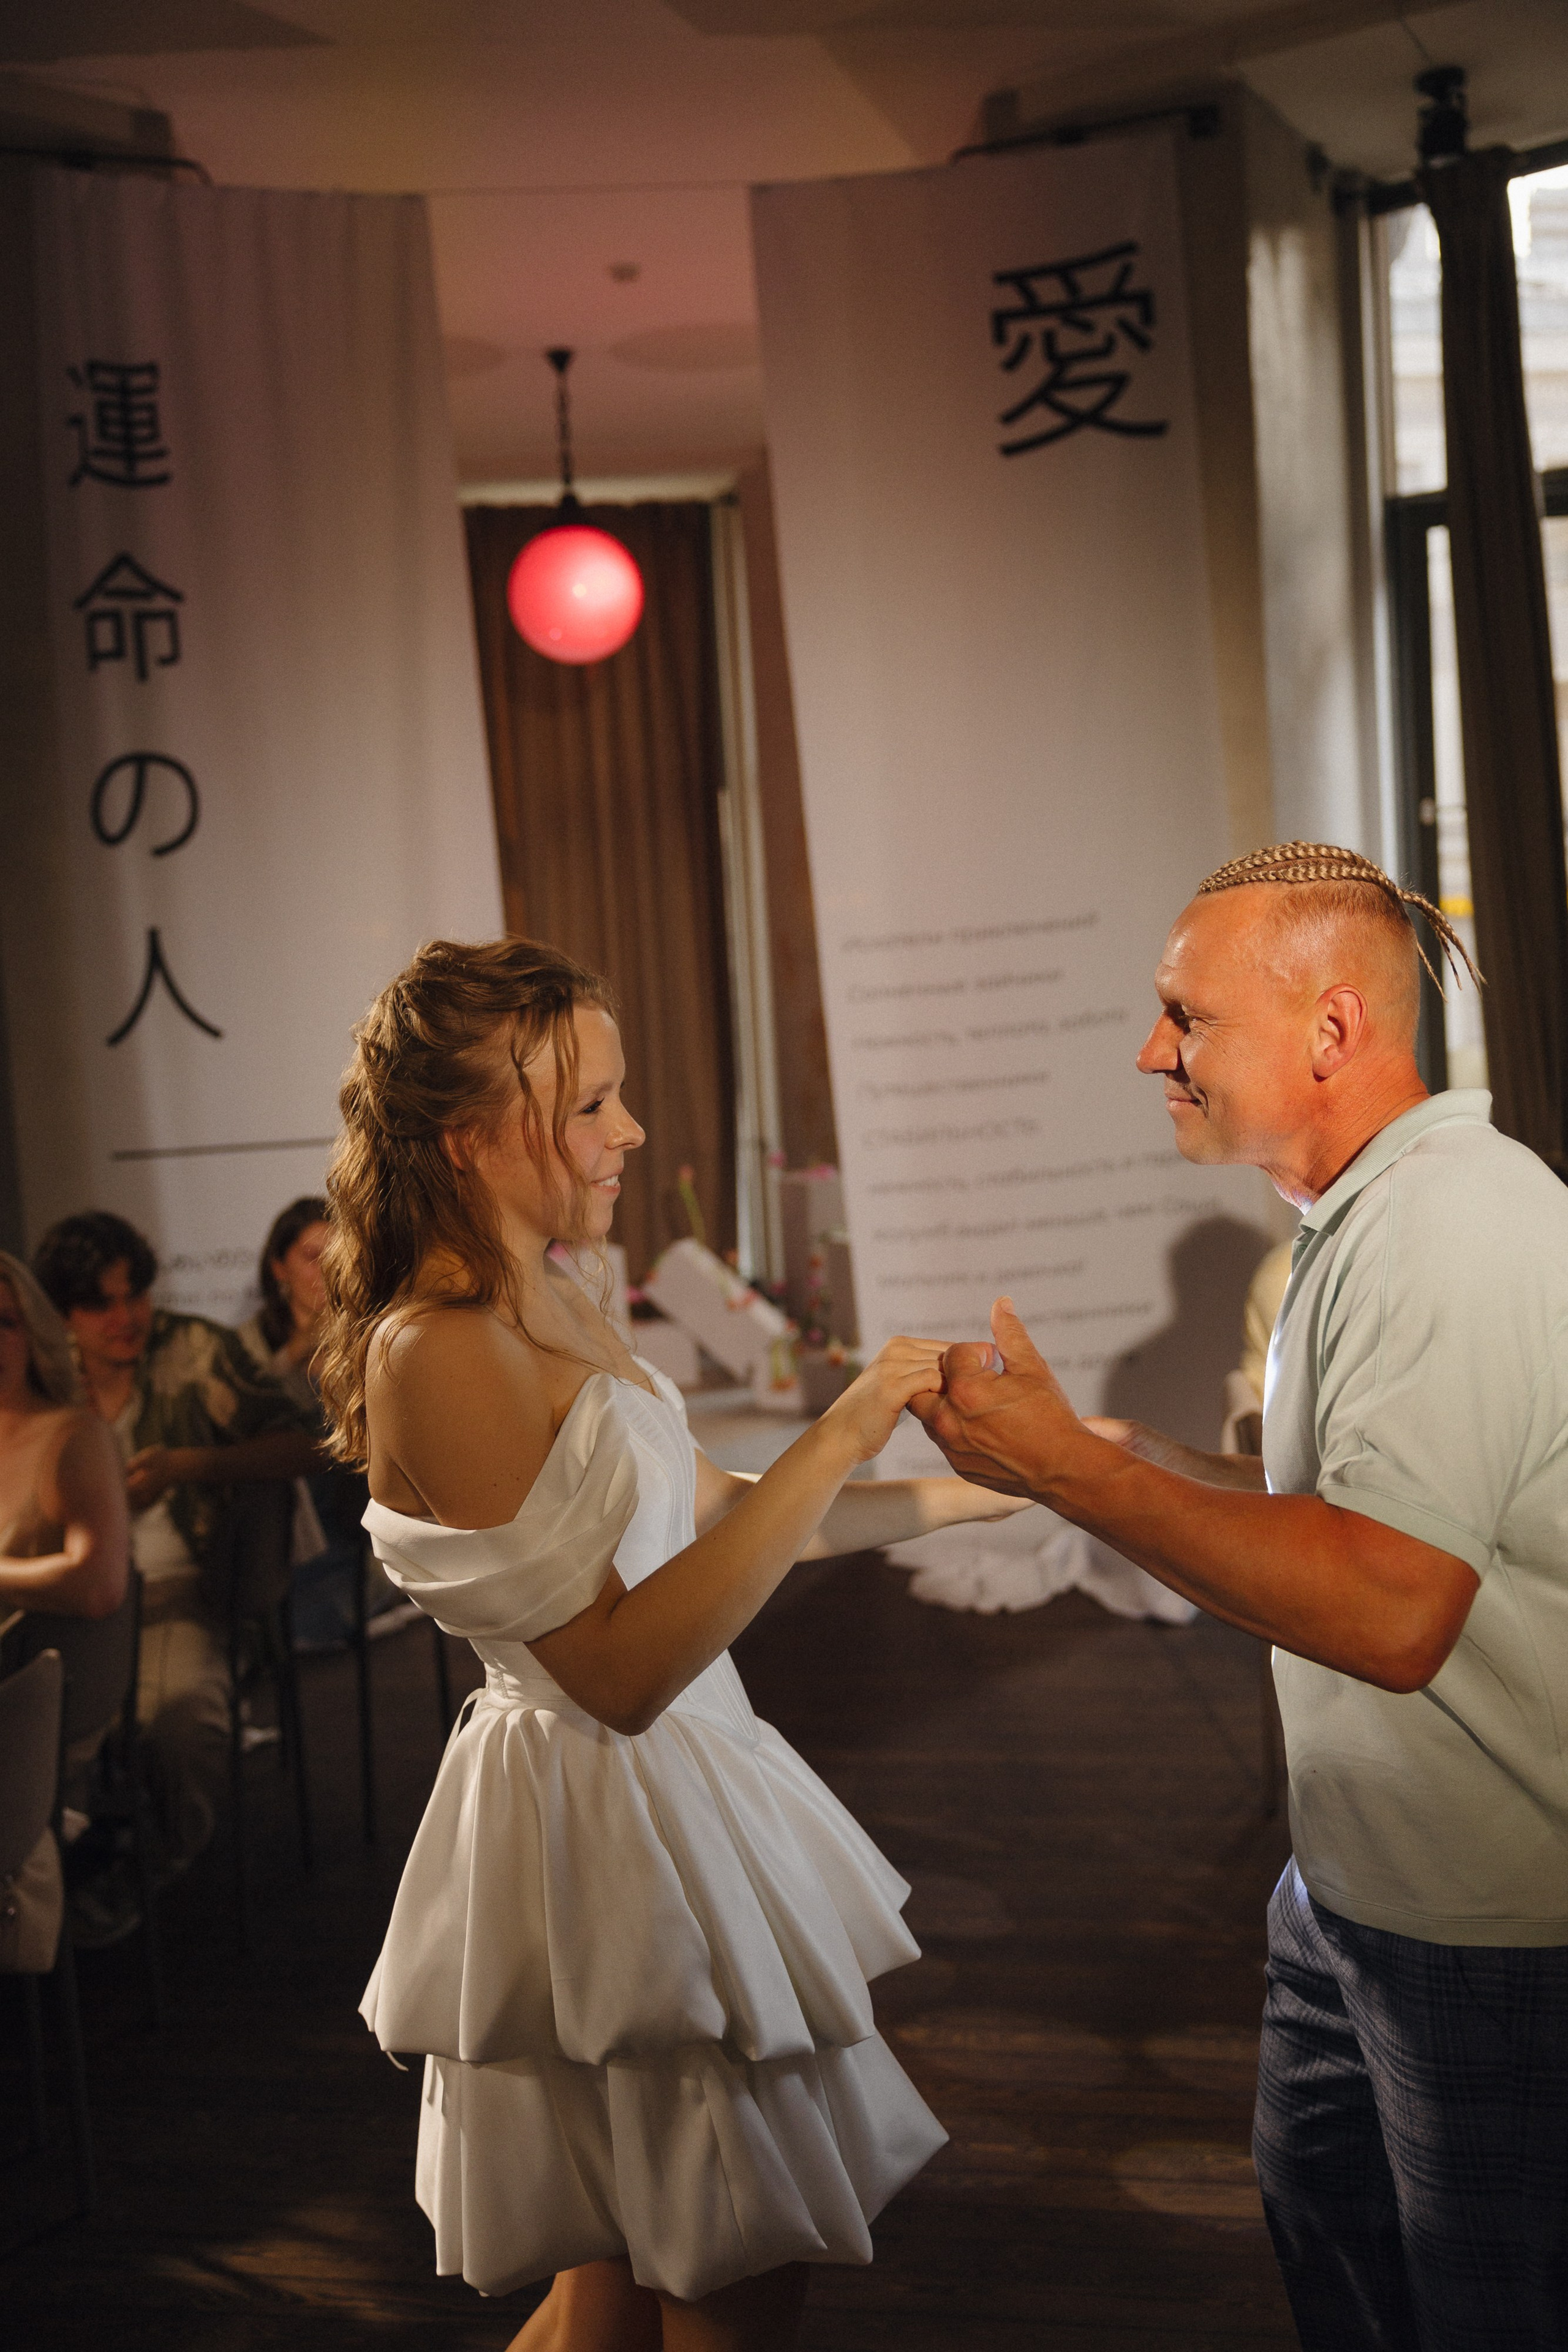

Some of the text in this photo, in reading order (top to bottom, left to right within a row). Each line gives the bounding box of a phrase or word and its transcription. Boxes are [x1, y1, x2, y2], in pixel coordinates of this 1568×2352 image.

[992, 241, 1169, 456] 愛
[66, 359, 224, 1047] 運命の人
